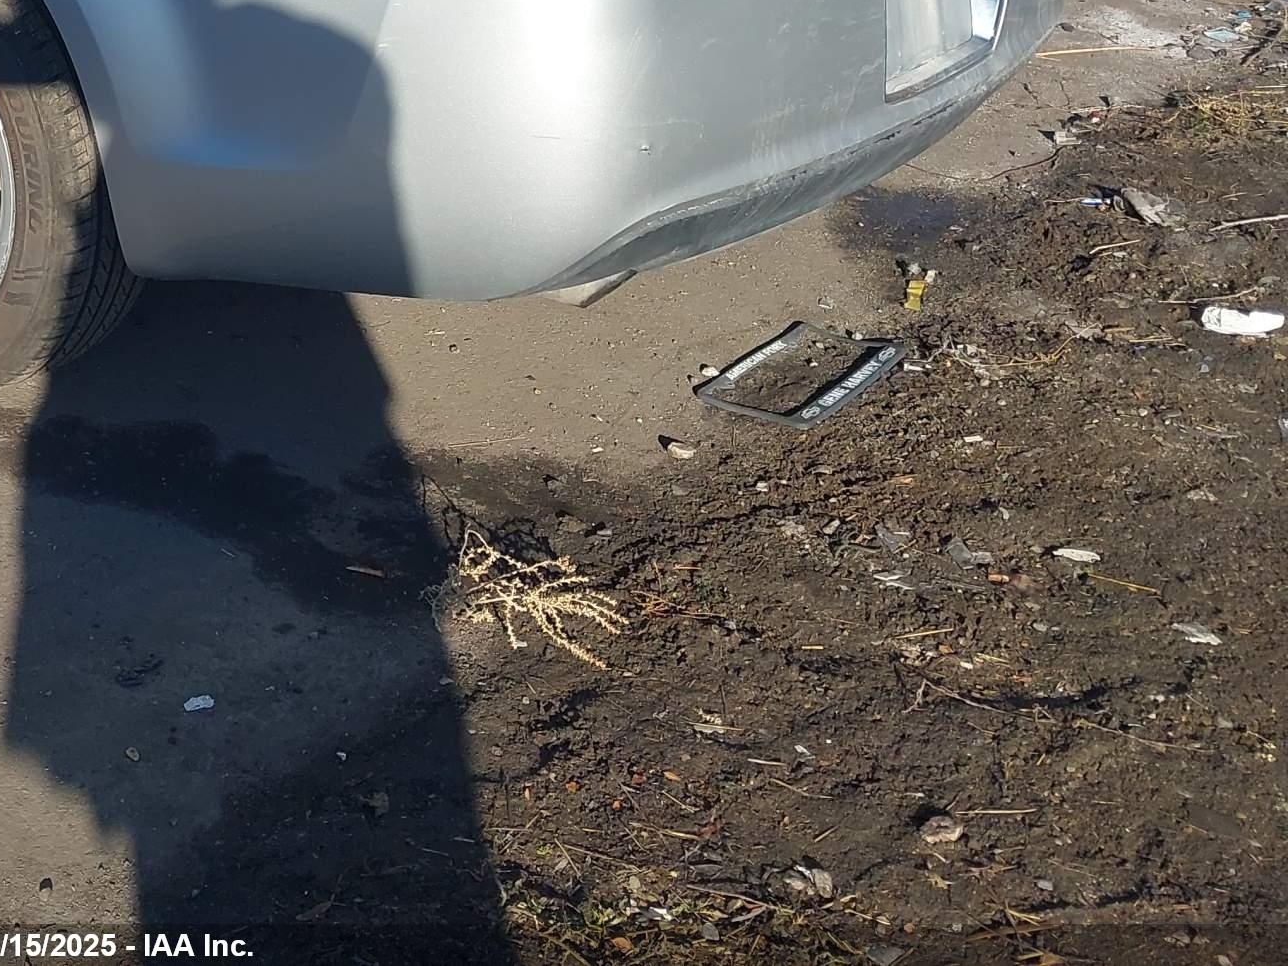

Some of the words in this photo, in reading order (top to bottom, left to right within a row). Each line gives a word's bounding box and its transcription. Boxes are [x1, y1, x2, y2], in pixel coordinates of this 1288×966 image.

[8, 89, 44, 234] OURING
[725, 351, 768, 381] AMERICAN
[762, 340, 788, 356] FORK
[817, 387, 851, 408] GENE
[841, 360, 882, 389] HARVEY
